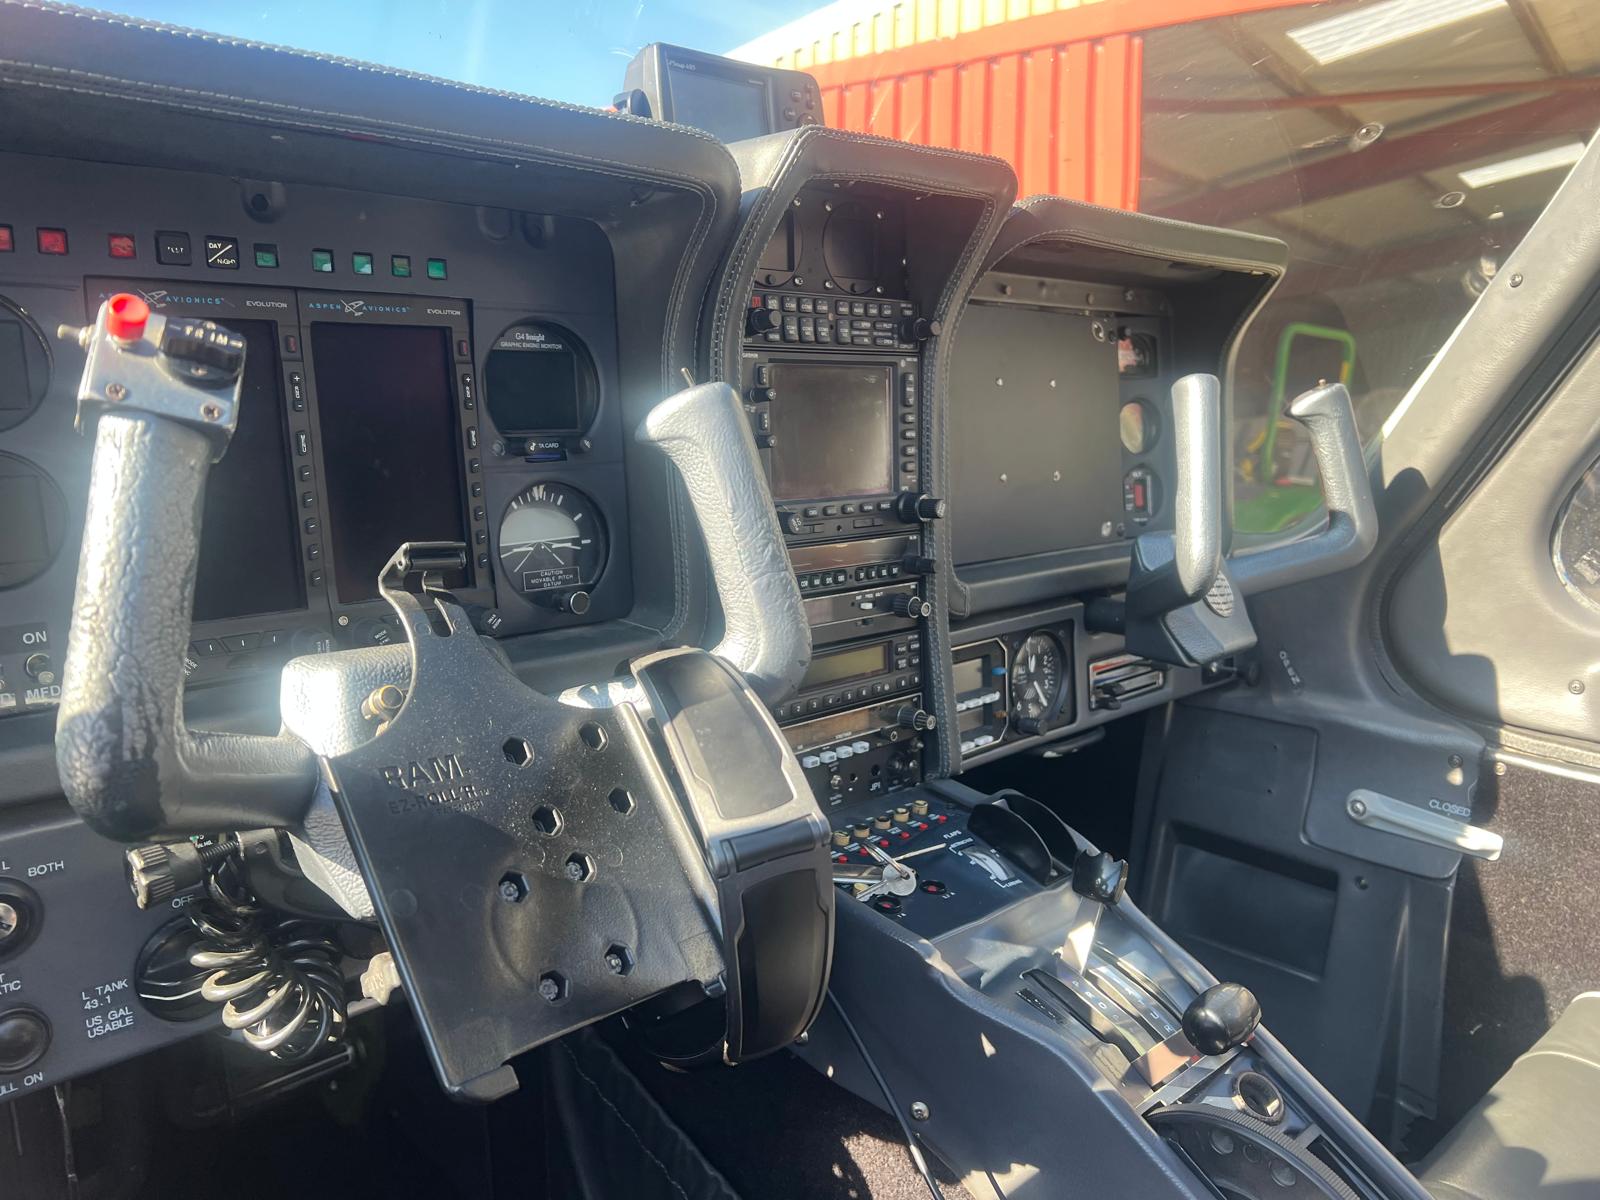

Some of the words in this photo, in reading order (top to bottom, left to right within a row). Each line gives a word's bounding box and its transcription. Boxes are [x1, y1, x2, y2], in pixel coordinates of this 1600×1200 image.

[165, 296, 222, 304] AVIONICS
[246, 300, 288, 308] EVOLUTION
[362, 305, 407, 313] AVIONICS
[426, 308, 461, 316] EVOLUTION
[184, 325, 229, 346] TRIM
[531, 576, 556, 584] MOVABLE
[22, 631, 47, 645] ON
[26, 685, 61, 700] MFD
[377, 754, 464, 790] RAM
[1429, 799, 1471, 817] CLOSED
[2, 861, 11, 870] L
[28, 861, 65, 877] BOTH
[172, 894, 195, 909] OFF
[0, 979, 21, 994] TIC
[82, 991, 90, 1001] L
[96, 979, 129, 996] TANK
[84, 995, 111, 1010] 43.1
[86, 1016, 103, 1028] US
[108, 1007, 134, 1020] GAL
[87, 1016, 134, 1039] USABLE
[24, 1071, 43, 1086] ON
